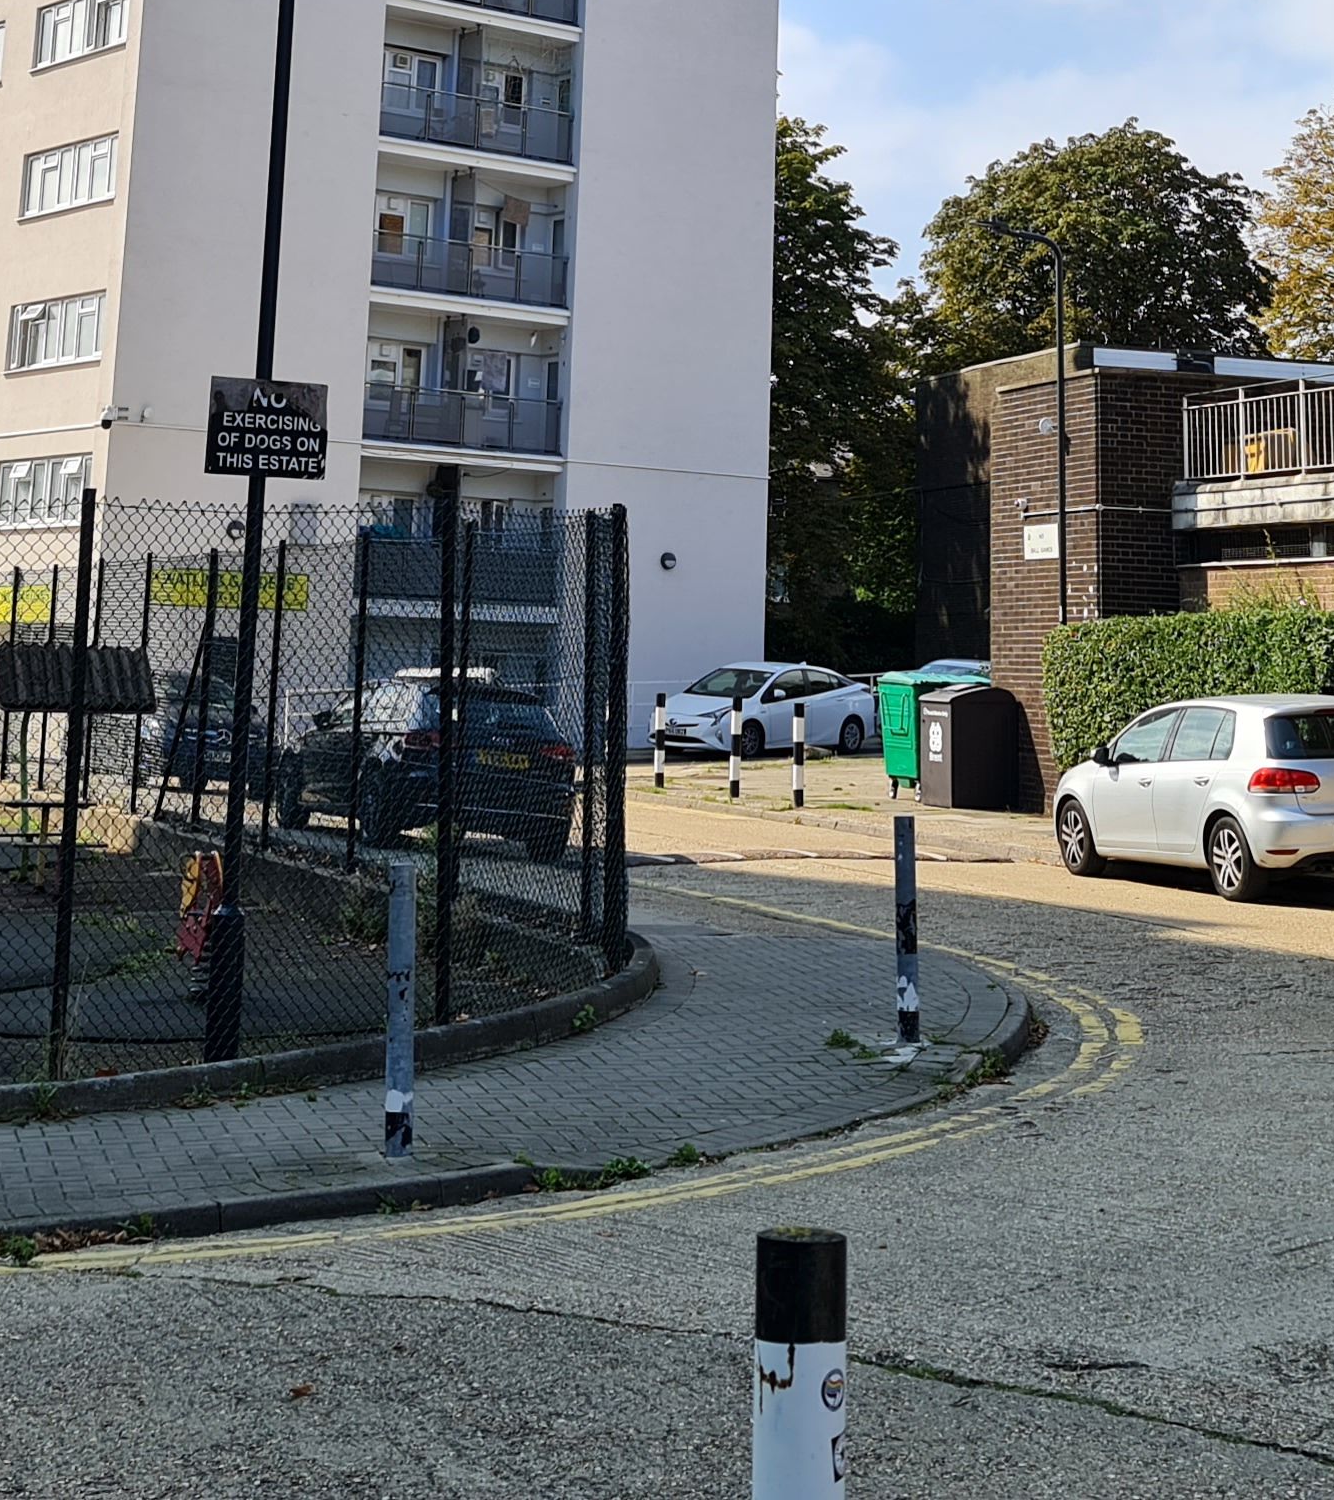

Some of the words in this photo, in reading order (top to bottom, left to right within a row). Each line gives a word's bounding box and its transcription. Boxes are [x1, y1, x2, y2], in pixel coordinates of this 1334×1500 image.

[253, 387, 287, 408] NO
[223, 412, 321, 432] EXERCISING
[218, 432, 240, 447] OF
[245, 434, 291, 450] DOGS
[297, 437, 319, 452] ON
[216, 452, 253, 468] THIS
[258, 455, 318, 472] ESTATE
